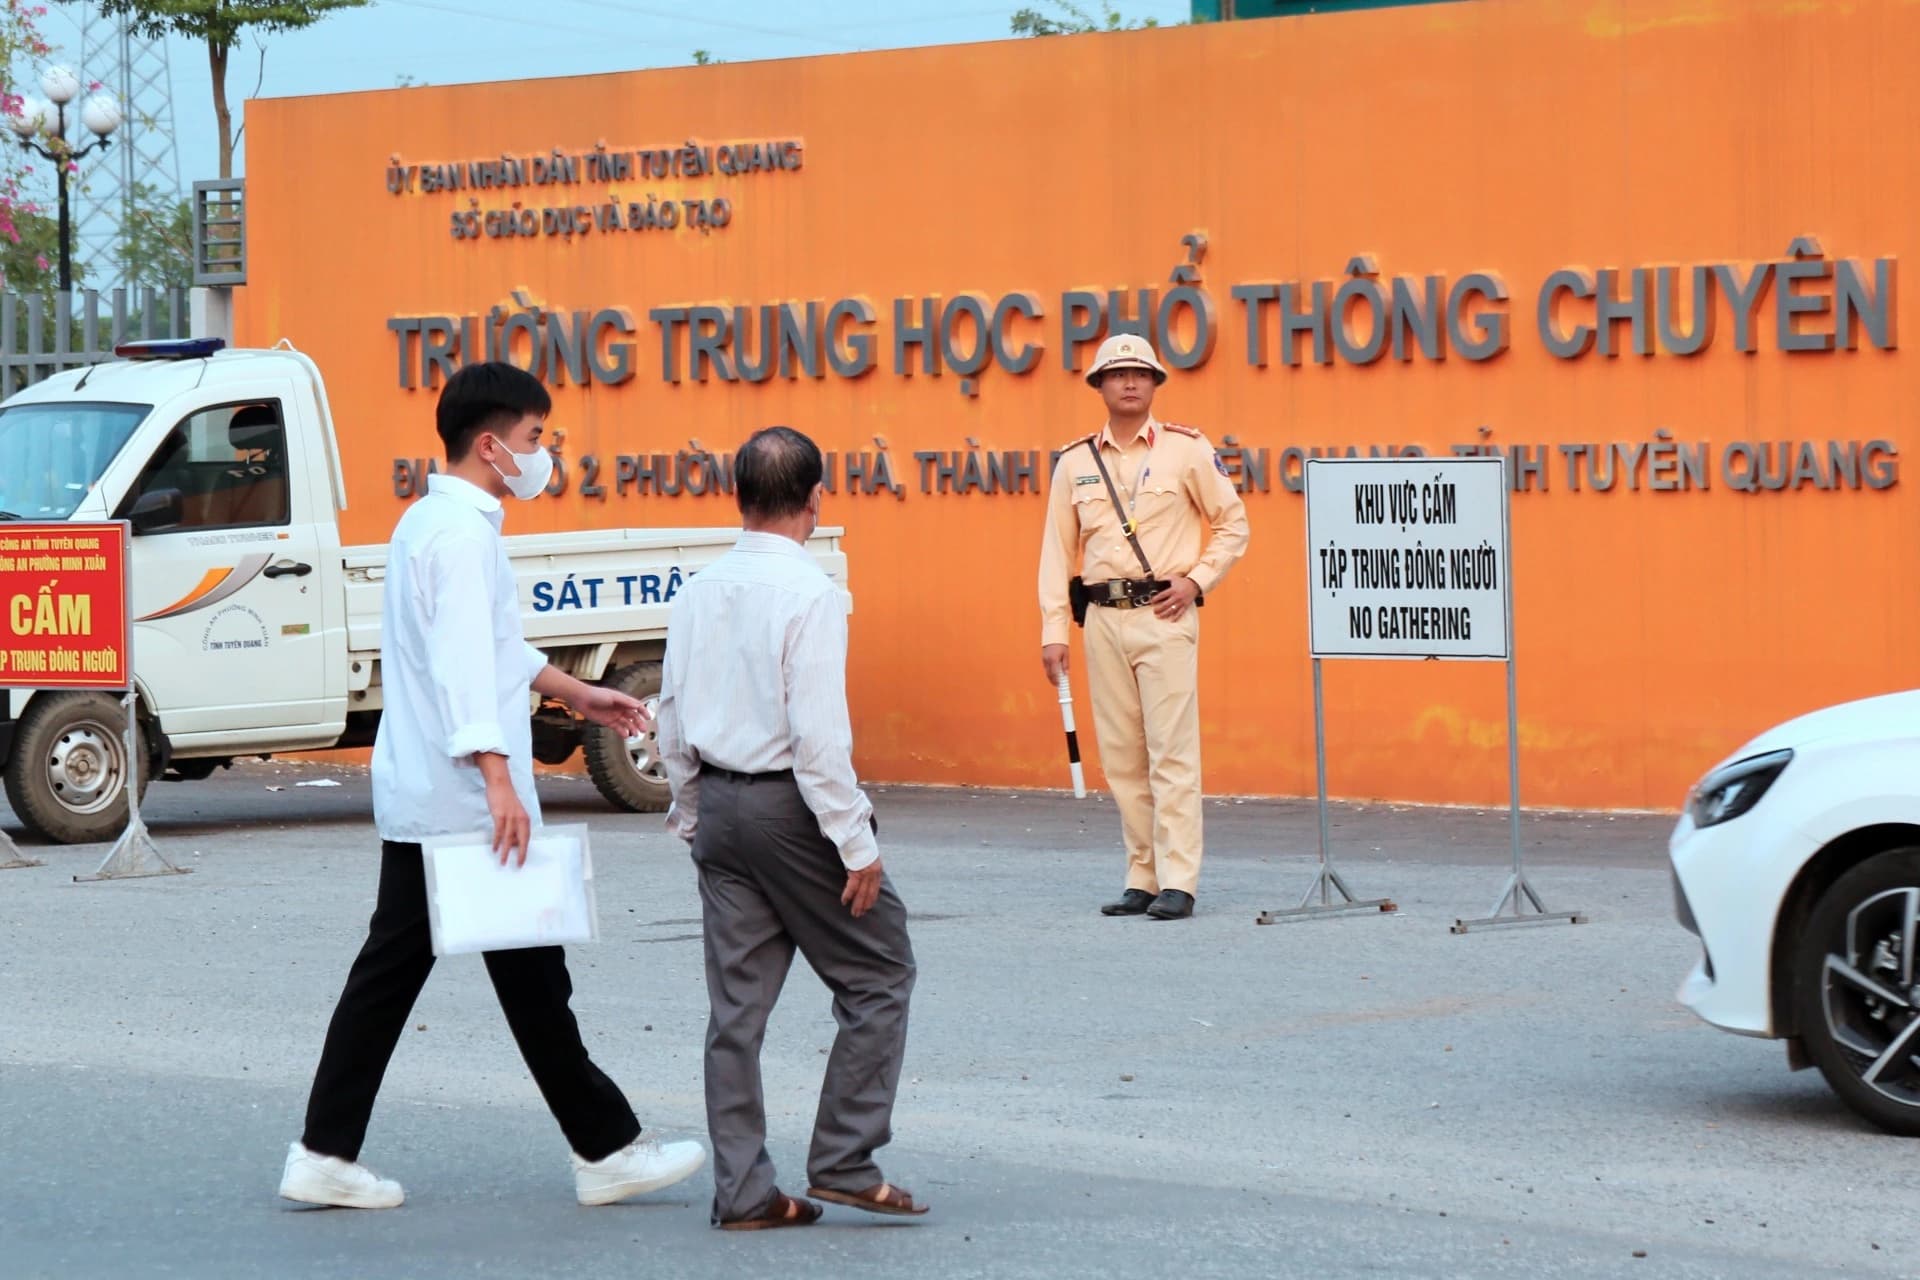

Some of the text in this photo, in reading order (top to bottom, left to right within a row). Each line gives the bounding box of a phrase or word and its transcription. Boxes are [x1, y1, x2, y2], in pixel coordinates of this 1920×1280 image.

[420, 163, 466, 193] BAN
[469, 154, 530, 189] NHÂN
[533, 148, 581, 185] DÂN
[583, 140, 634, 183] TỈNH
[637, 139, 713, 179] TUYÊN
[717, 140, 803, 176] QUANG
[485, 202, 539, 238] GIÁO
[543, 205, 591, 243] DỤC
[592, 194, 627, 234] VÀ
[629, 193, 680, 231] ĐÀO
[682, 197, 732, 236] TẠO
[387, 233, 1897, 398] TRƯỜNG TRUNG HỌC PHỔ THÔNG CHUYÊN
[616, 439, 736, 497] PHƯỜN
[914, 437, 1041, 495] THÀNH
[1559, 428, 1711, 492] TUYÊN
[1721, 439, 1898, 494] QUANG
[1355, 472, 1457, 533] KHU VỰC CẤM
[532, 573, 605, 613] SÁT
[1320, 539, 1497, 598] TẬP TRUNG ĐÔNG NGƯỜI
[10, 579, 91, 636] CẤM
[1349, 606, 1471, 640] NO GATHERING
[10, 650, 47, 672] TRUNG
[49, 645, 80, 672] ĐÔNG
[82, 645, 117, 673] NGƯỜI
